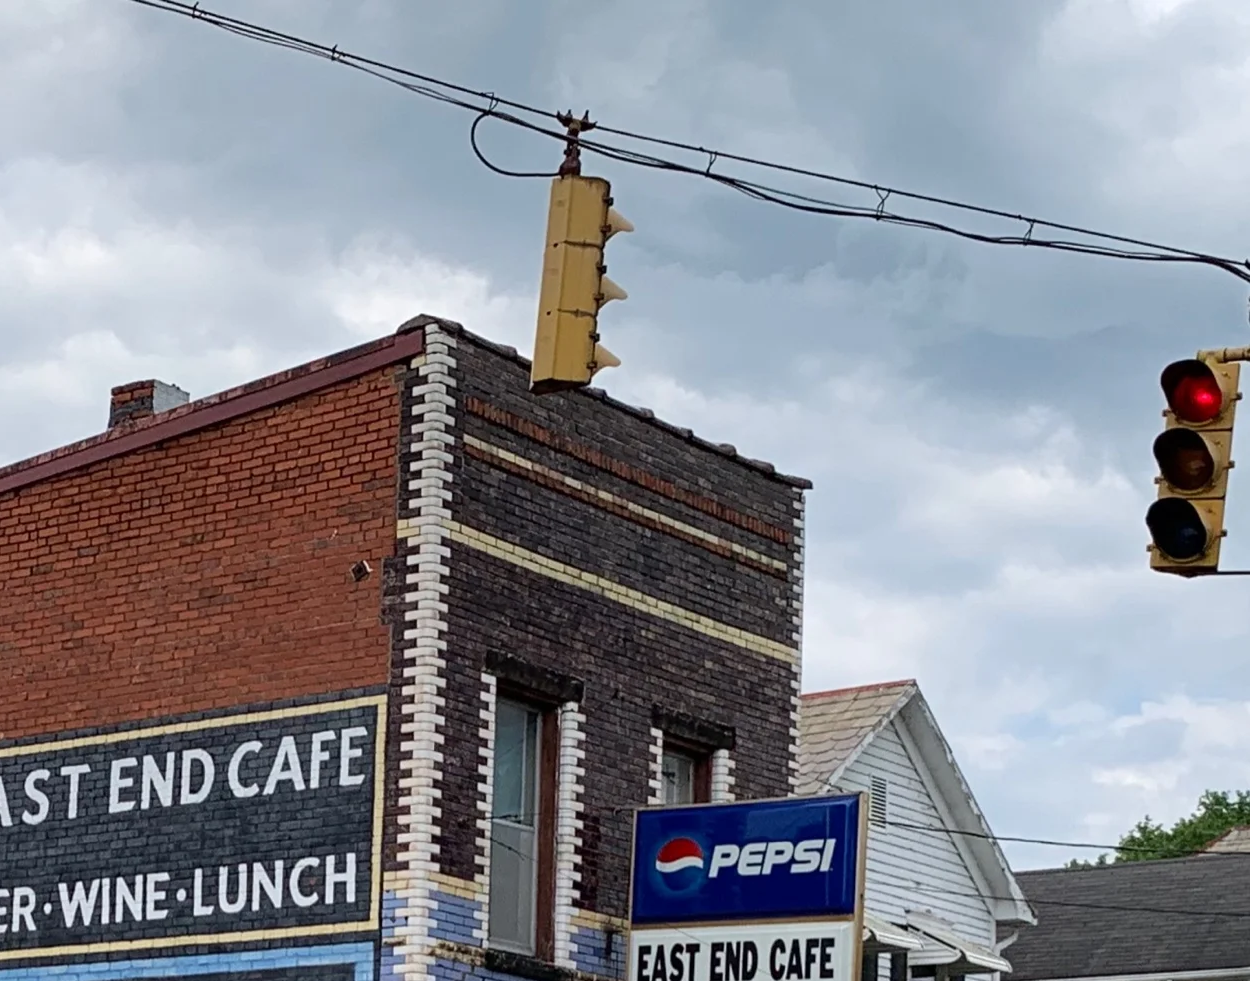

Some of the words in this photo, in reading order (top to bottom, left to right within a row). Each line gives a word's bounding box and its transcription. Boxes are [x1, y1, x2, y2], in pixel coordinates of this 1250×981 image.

[108, 747, 214, 813] END
[228, 726, 368, 798] CAFE
[708, 838, 836, 878] PEPSI
[58, 872, 171, 928] WINE
[193, 852, 356, 916] LUNCH
[710, 941, 758, 981] END
[769, 937, 835, 981] CAFE
